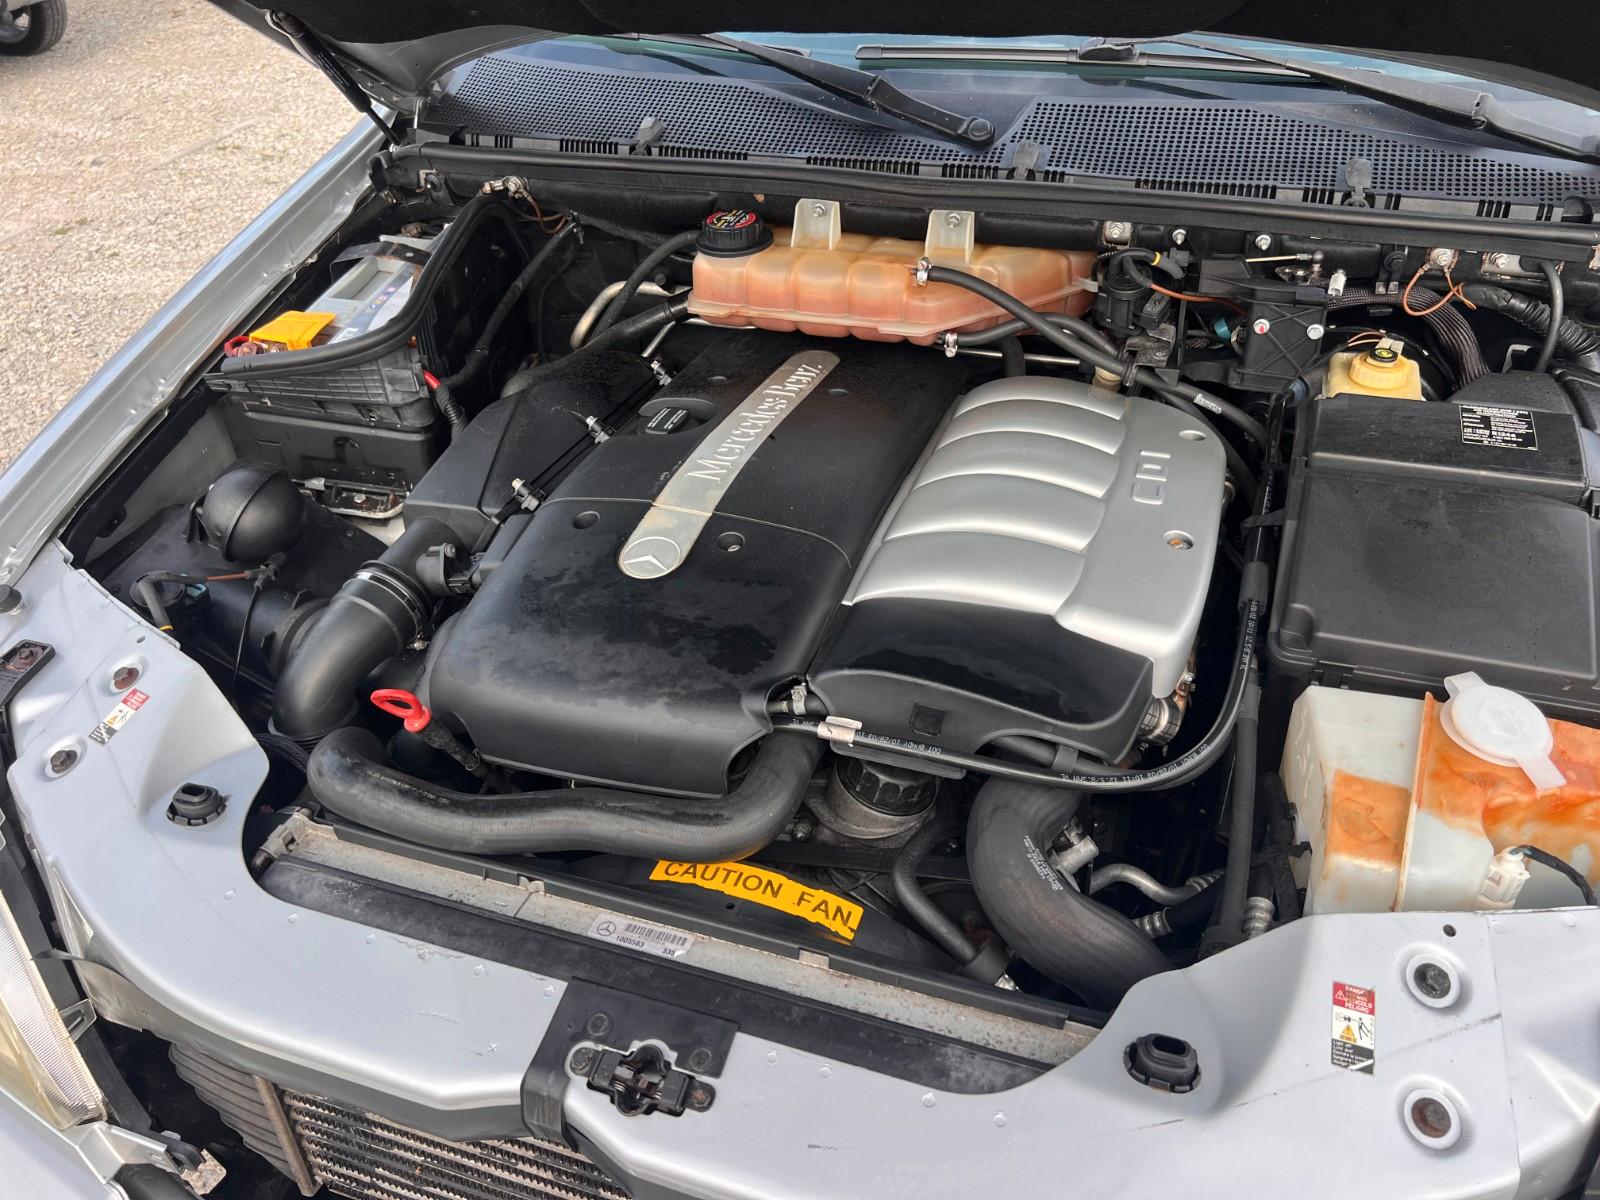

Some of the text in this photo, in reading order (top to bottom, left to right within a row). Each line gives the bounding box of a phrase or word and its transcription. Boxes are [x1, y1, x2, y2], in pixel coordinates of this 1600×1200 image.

[1131, 449, 1171, 505] CDI
[664, 862, 853, 928] CAUTION FAN
[615, 934, 645, 948] 1005583
